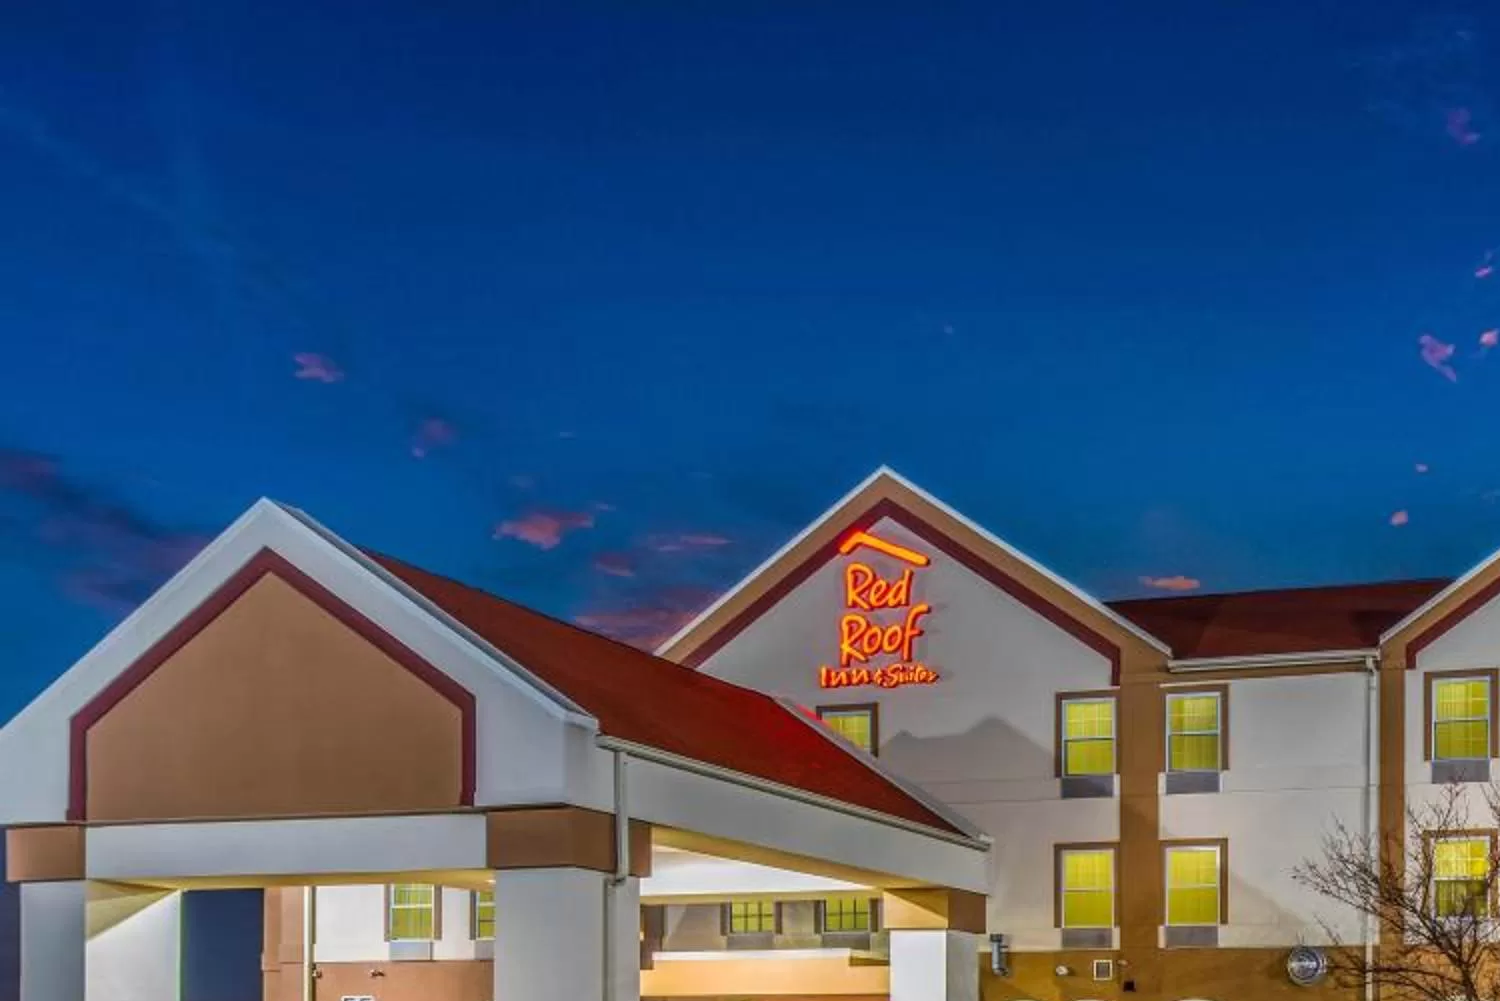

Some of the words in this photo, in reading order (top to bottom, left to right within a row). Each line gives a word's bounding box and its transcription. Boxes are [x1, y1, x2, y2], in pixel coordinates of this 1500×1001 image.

[845, 562, 913, 611] Red
[840, 602, 931, 667] Roof
[820, 665, 871, 688] Inn
[882, 663, 939, 688] Suites
